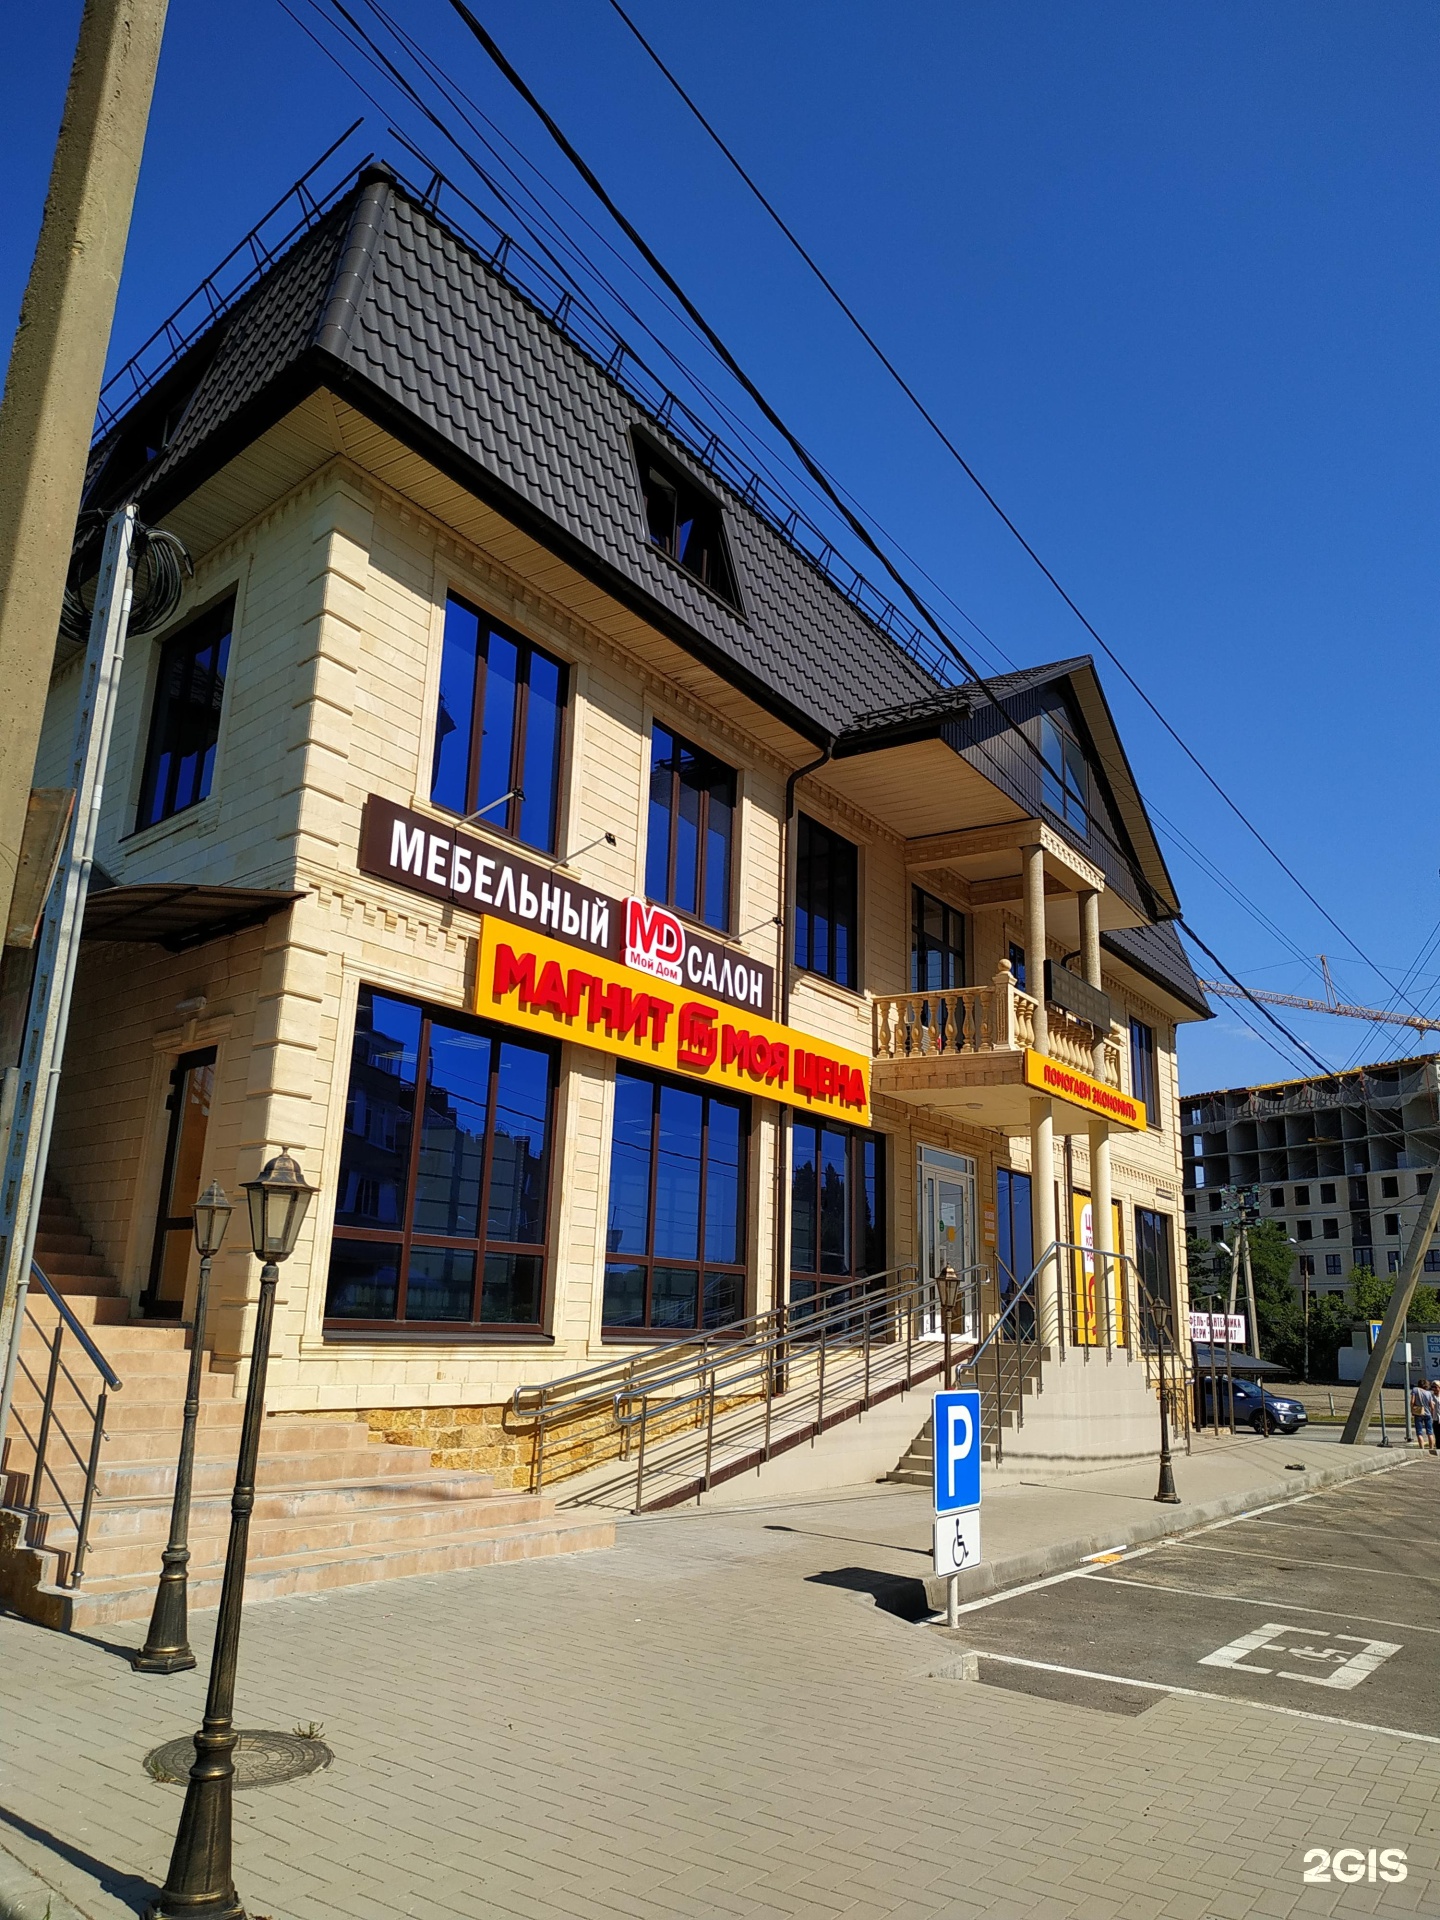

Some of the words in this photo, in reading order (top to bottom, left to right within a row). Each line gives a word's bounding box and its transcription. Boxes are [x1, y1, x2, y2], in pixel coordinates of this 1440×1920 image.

[389, 819, 610, 949] МЕБЕЛЬНЫЙ
[687, 945, 763, 1008] САЛОН
[630, 951, 654, 971] Мой
[656, 962, 678, 980] Дом
[493, 943, 673, 1044] МАГНИТ
[722, 1024, 789, 1082] МОЯ
[794, 1049, 867, 1106] ЦЕНА
[1044, 1064, 1091, 1101] ПОМОГАЕМ
[1092, 1087, 1137, 1121] ЭКОНОМИТЬ
[947, 1405, 974, 1497] P
